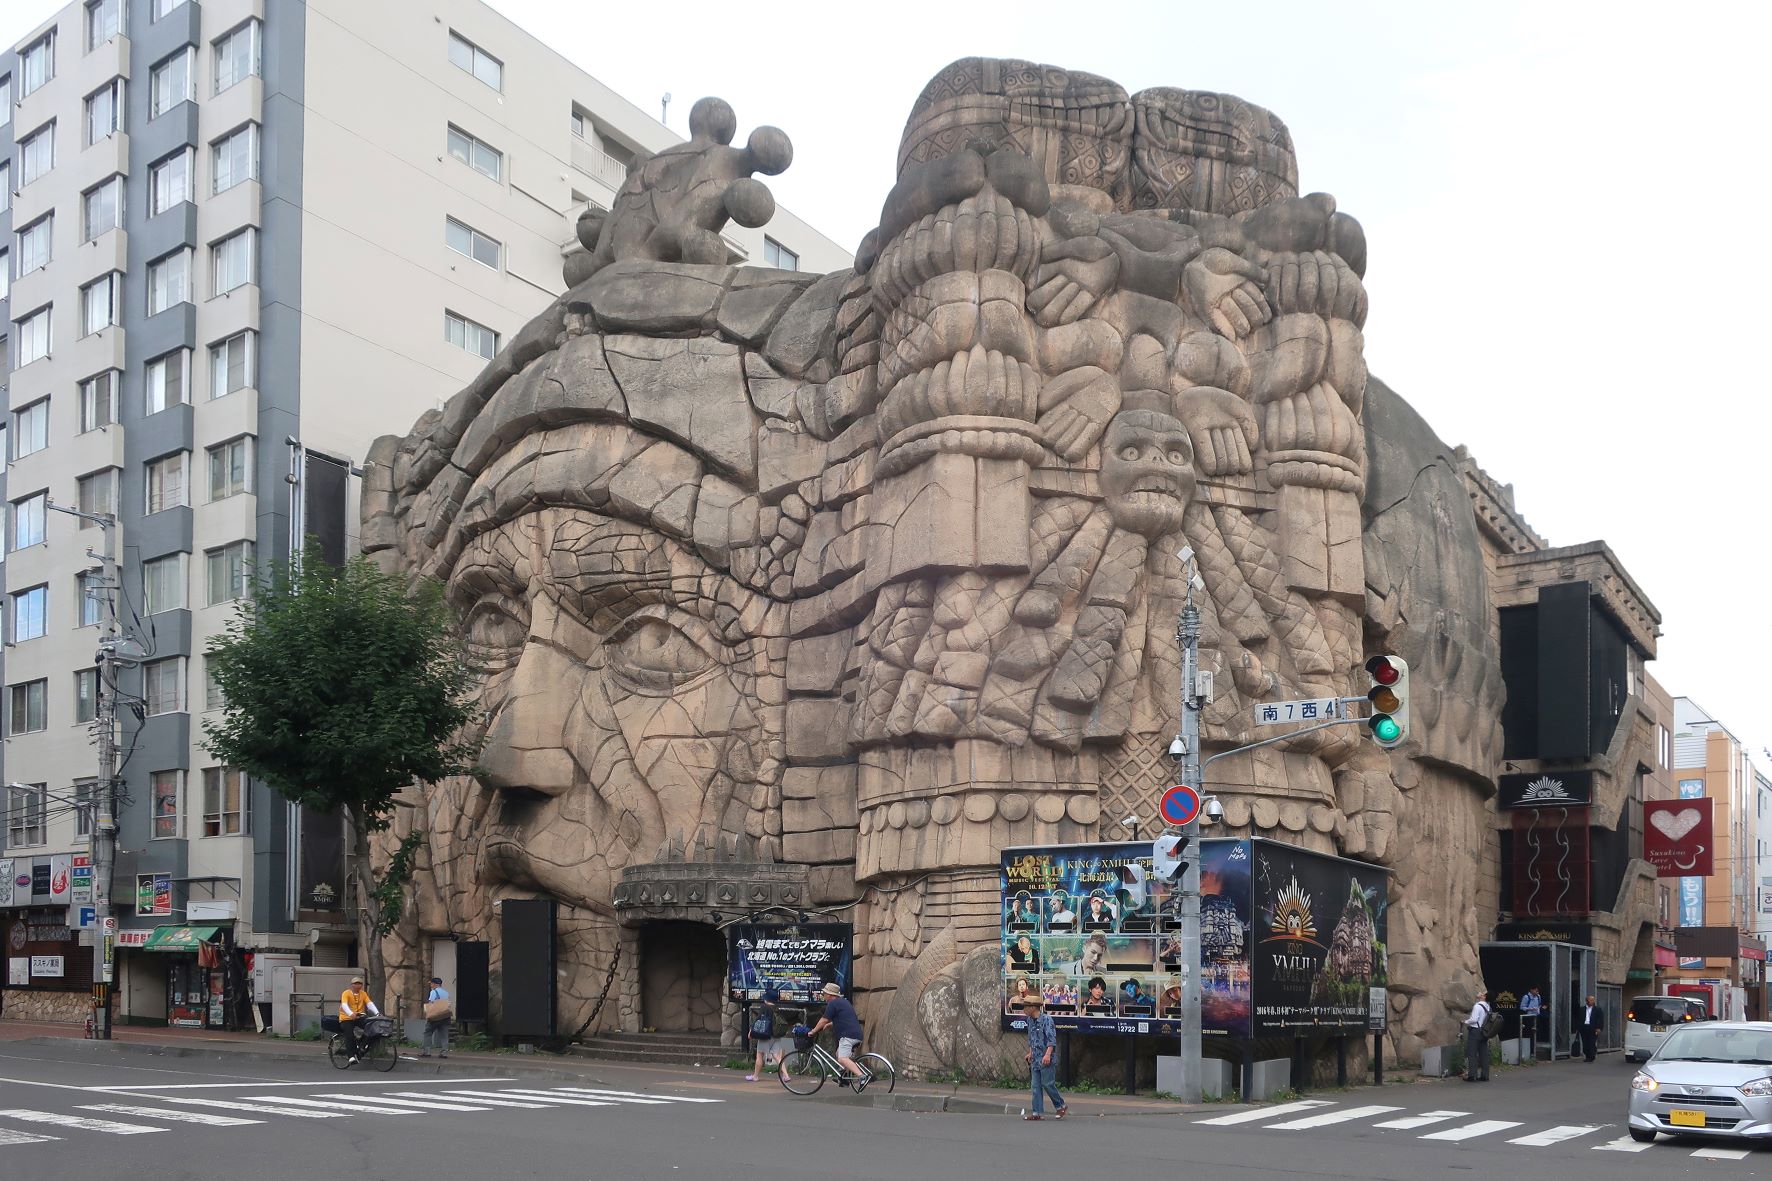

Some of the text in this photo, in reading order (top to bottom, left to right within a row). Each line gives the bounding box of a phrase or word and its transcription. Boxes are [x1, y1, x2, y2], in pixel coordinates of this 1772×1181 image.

[1263, 701, 1333, 721] 南7西4
[1013, 854, 1053, 868] LOST
[1006, 865, 1064, 879] WORLD
[80, 908, 95, 926] P
[120, 933, 153, 944] 車庫前駐
[1117, 1025, 1136, 1033] 12722
